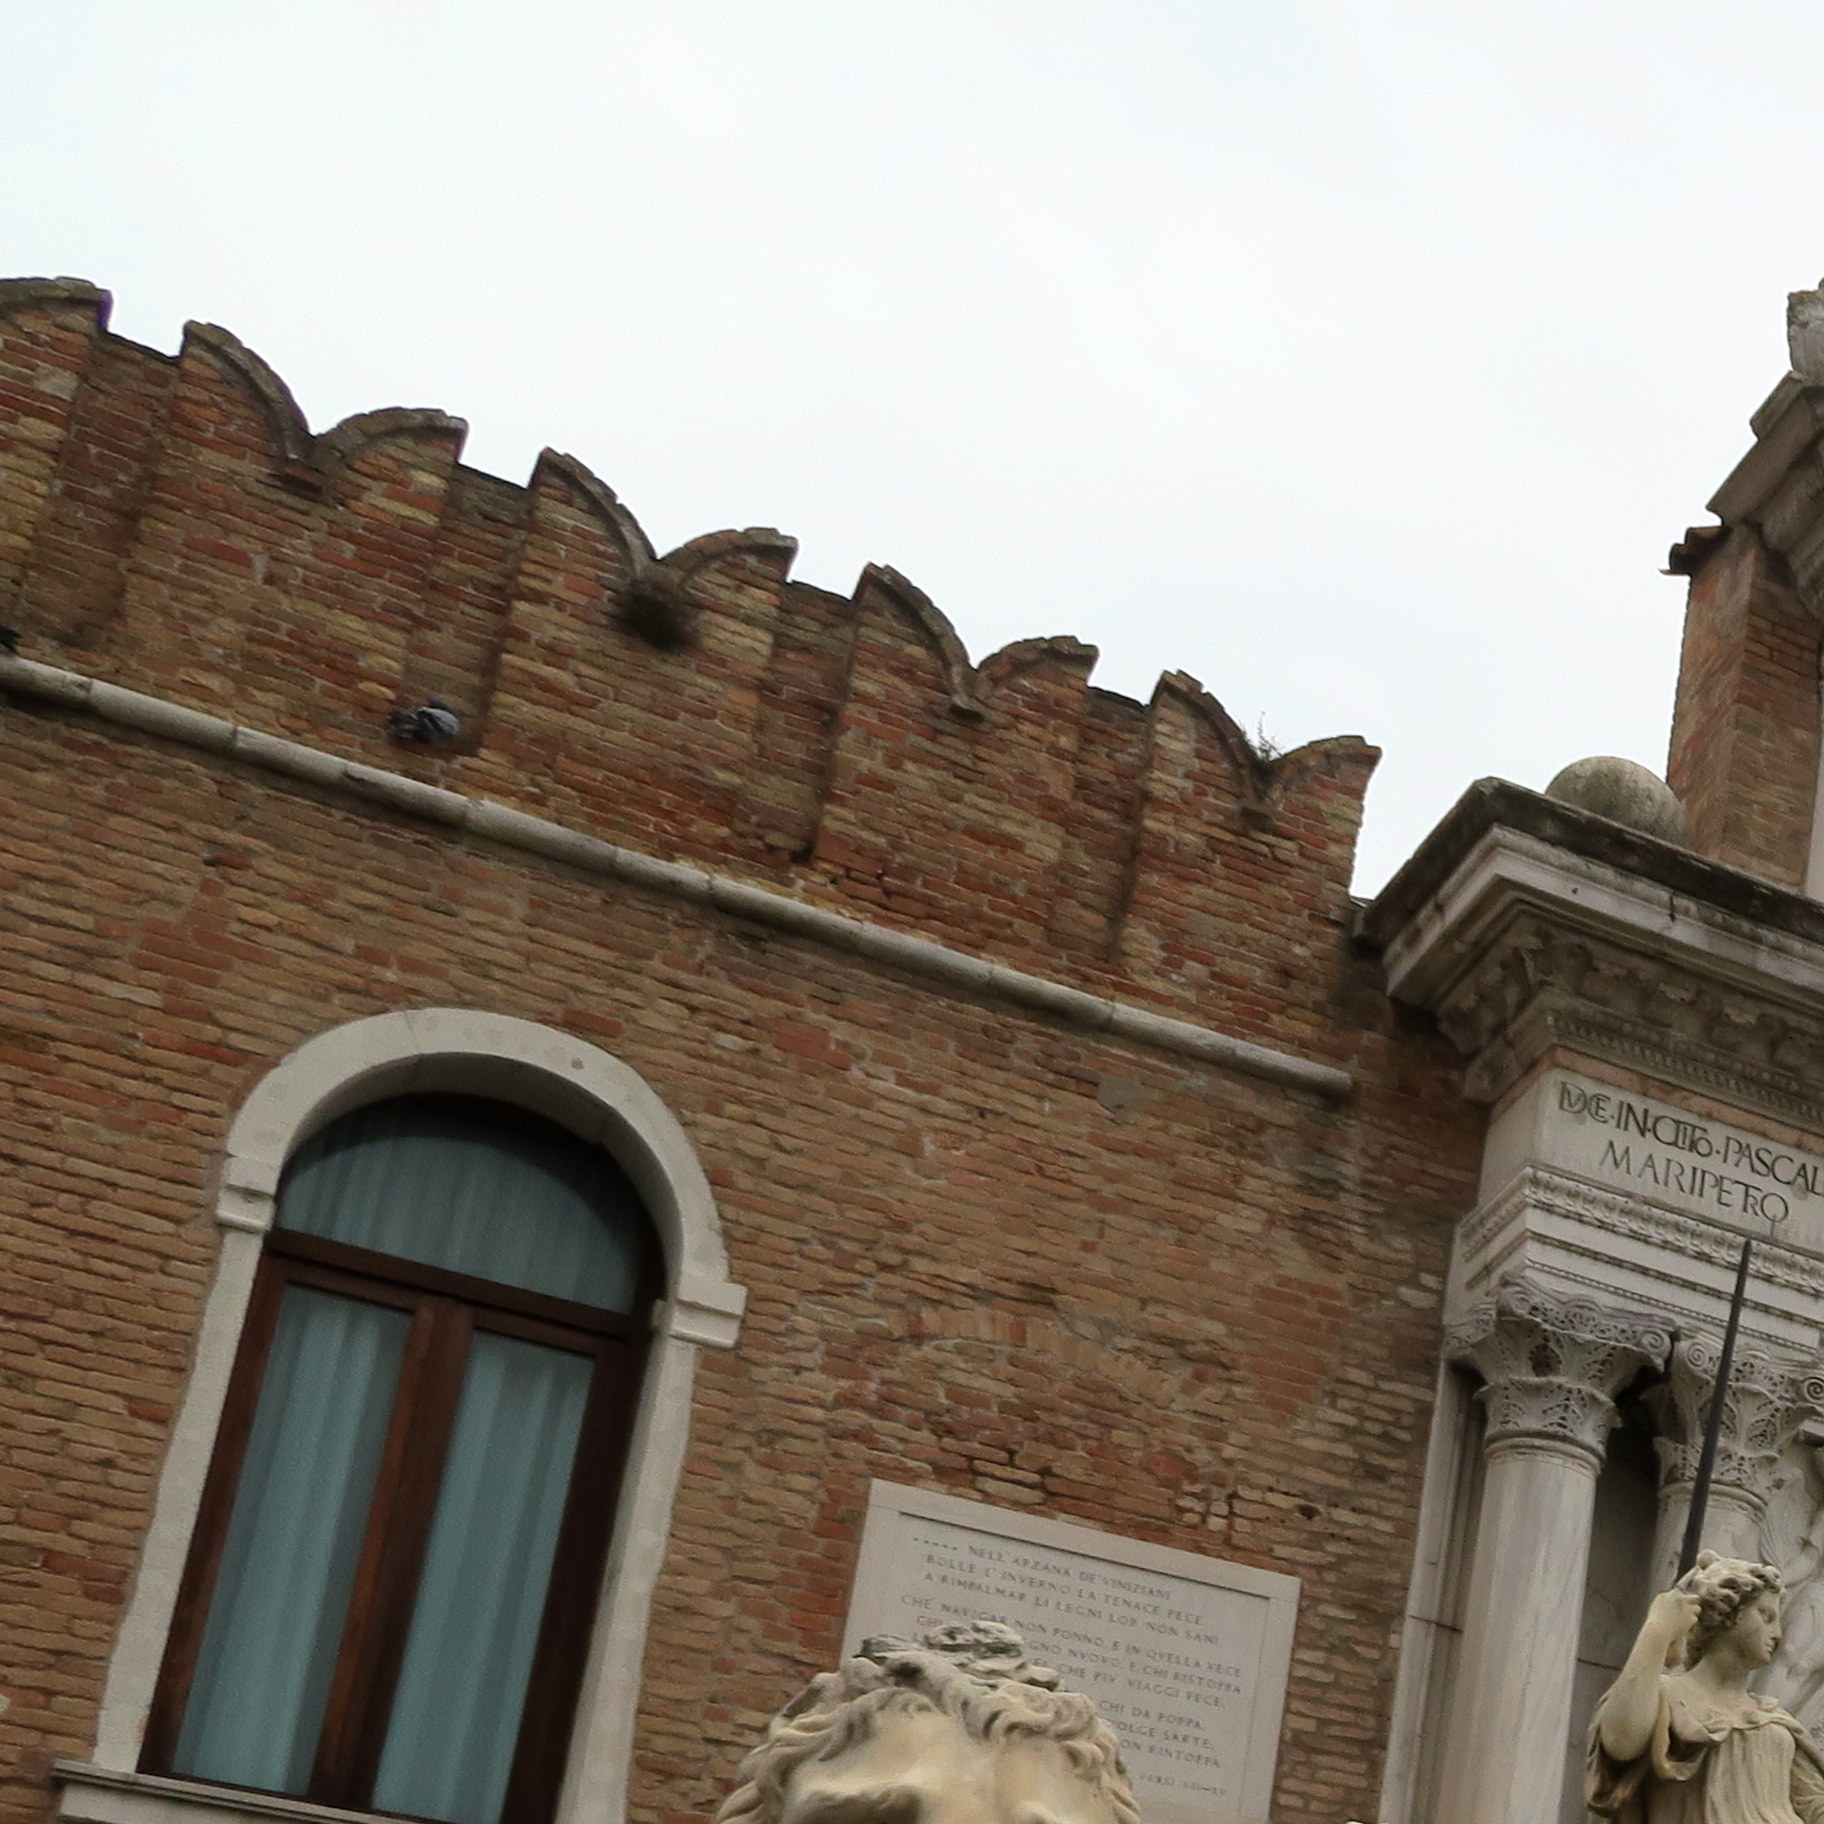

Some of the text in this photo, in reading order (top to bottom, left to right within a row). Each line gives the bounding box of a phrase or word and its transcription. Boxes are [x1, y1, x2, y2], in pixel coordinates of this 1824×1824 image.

[1104, 1593, 1161, 1616] TENACE
[1167, 1608, 1203, 1626] PECE
[1146, 1621, 1179, 1637] NON
